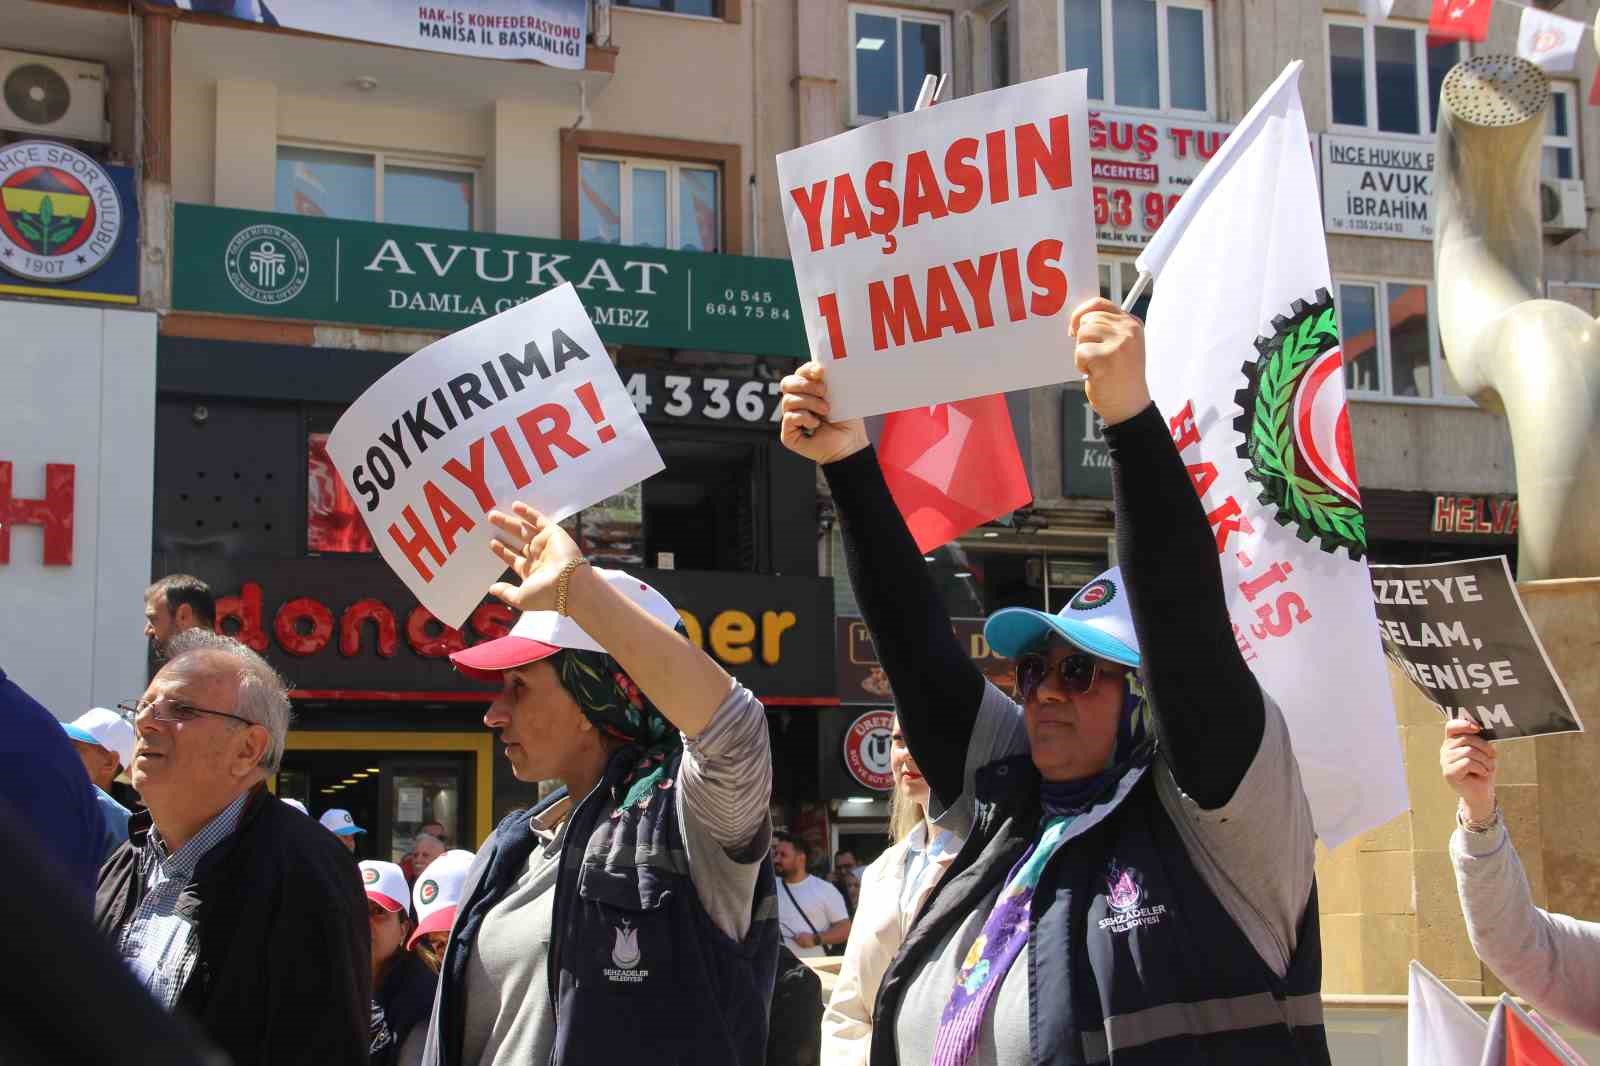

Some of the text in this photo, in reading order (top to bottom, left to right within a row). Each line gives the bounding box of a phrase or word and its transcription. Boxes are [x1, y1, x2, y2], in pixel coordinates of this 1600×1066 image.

[419, 22, 580, 57] MANİSA İL BAŞKANLIĞI
[468, 14, 580, 40] KONFEDERASYONU
[1171, 127, 1231, 161] TU
[1329, 140, 1365, 163] İNCE
[1369, 148, 1421, 169] HUKUK
[0, 149, 41, 176] HÇE
[47, 148, 99, 185] SPOR
[1093, 164, 1155, 181] ACENTESİ
[790, 114, 1072, 255] YAŞASIN
[1360, 171, 1433, 196] AVUK
[1346, 189, 1428, 220] İBRAHİM
[24, 257, 65, 274] 1907
[363, 239, 668, 295] AVUKAT
[388, 289, 487, 315] DAMLA
[706, 303, 791, 321] 664 75 84
[724, 289, 772, 304] 0 545
[818, 239, 1068, 360] 1 MAYIS
[353, 328, 590, 512] SOYKIRIMA
[387, 382, 617, 584] HAYIR!
[1376, 619, 1483, 651] SELAM,
